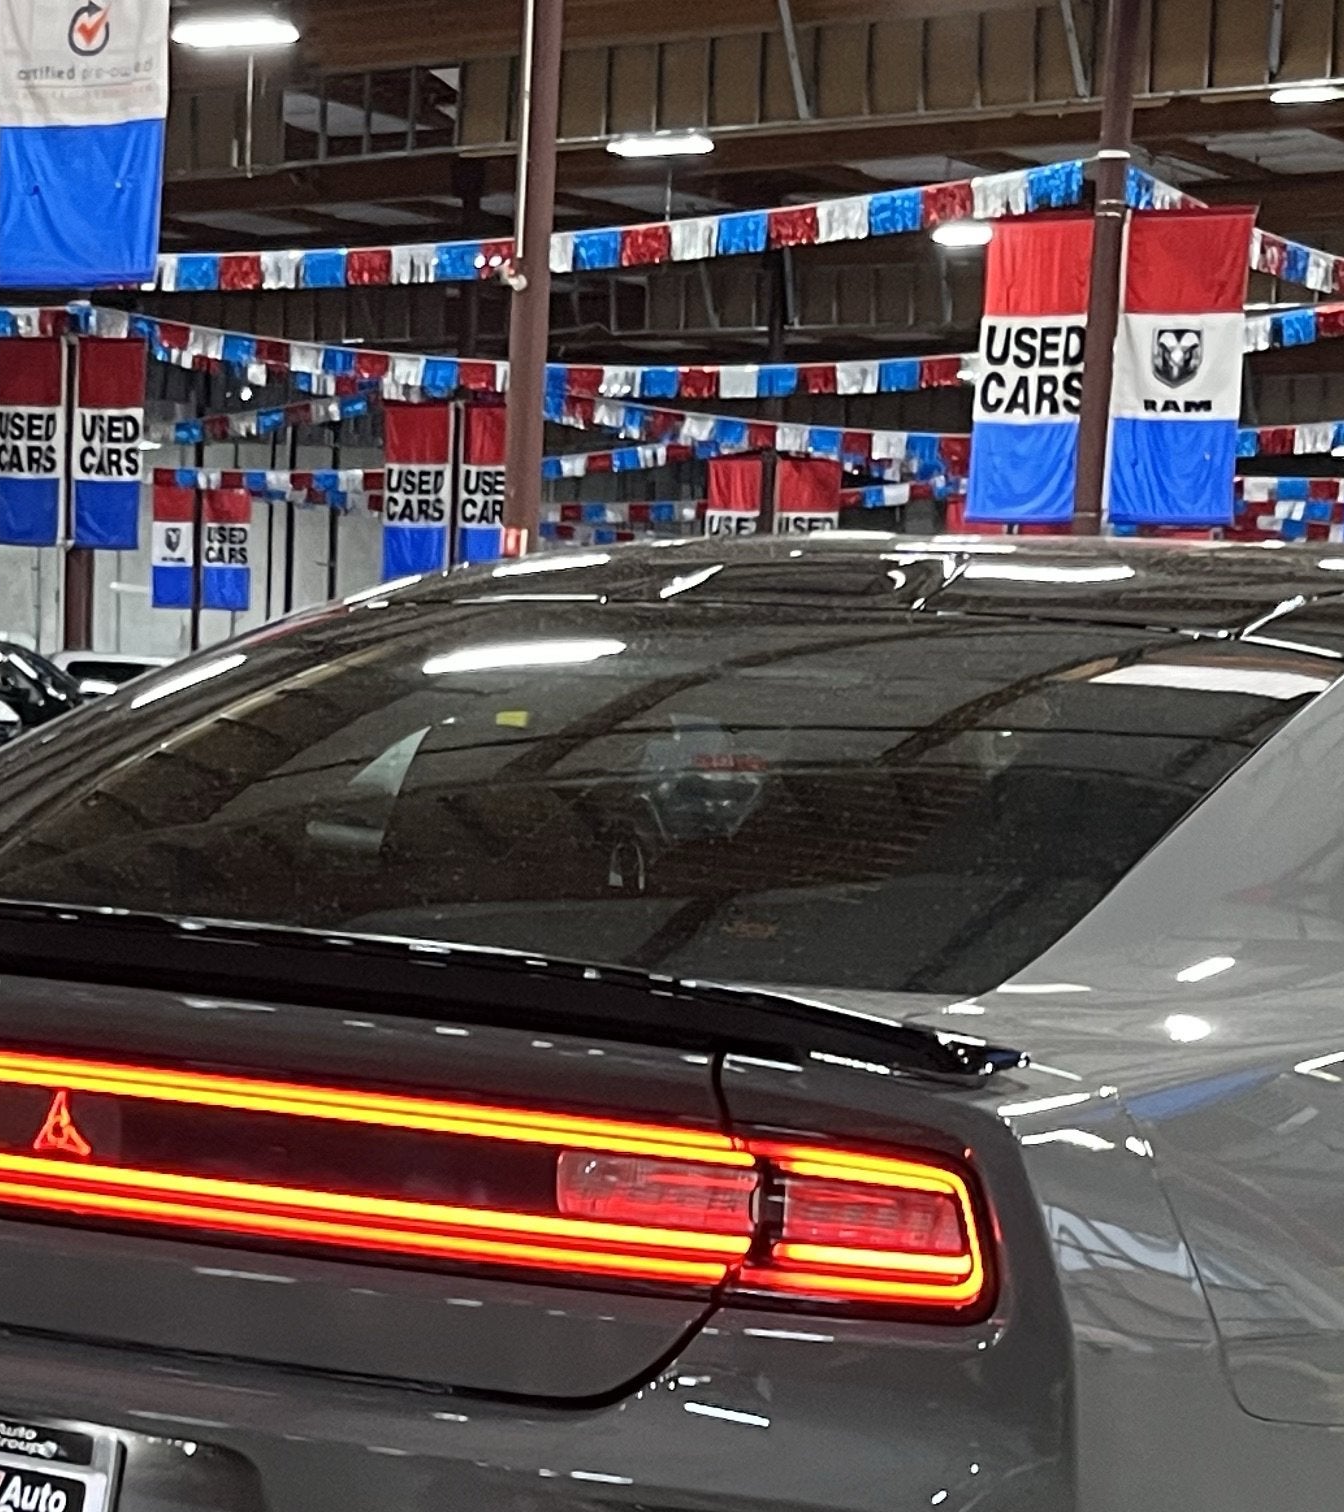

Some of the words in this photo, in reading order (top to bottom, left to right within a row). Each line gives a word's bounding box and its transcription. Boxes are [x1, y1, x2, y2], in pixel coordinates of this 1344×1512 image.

[985, 325, 1086, 369] USED
[980, 371, 1084, 415] CARS
[1143, 399, 1213, 413] RAM
[81, 413, 140, 443] USED
[80, 446, 140, 476] CARS
[387, 467, 445, 495] USED
[464, 469, 506, 495] USE
[386, 496, 444, 522] CARS
[462, 498, 504, 524] CAR
[207, 526, 248, 545] USED
[205, 547, 248, 564] CARS
